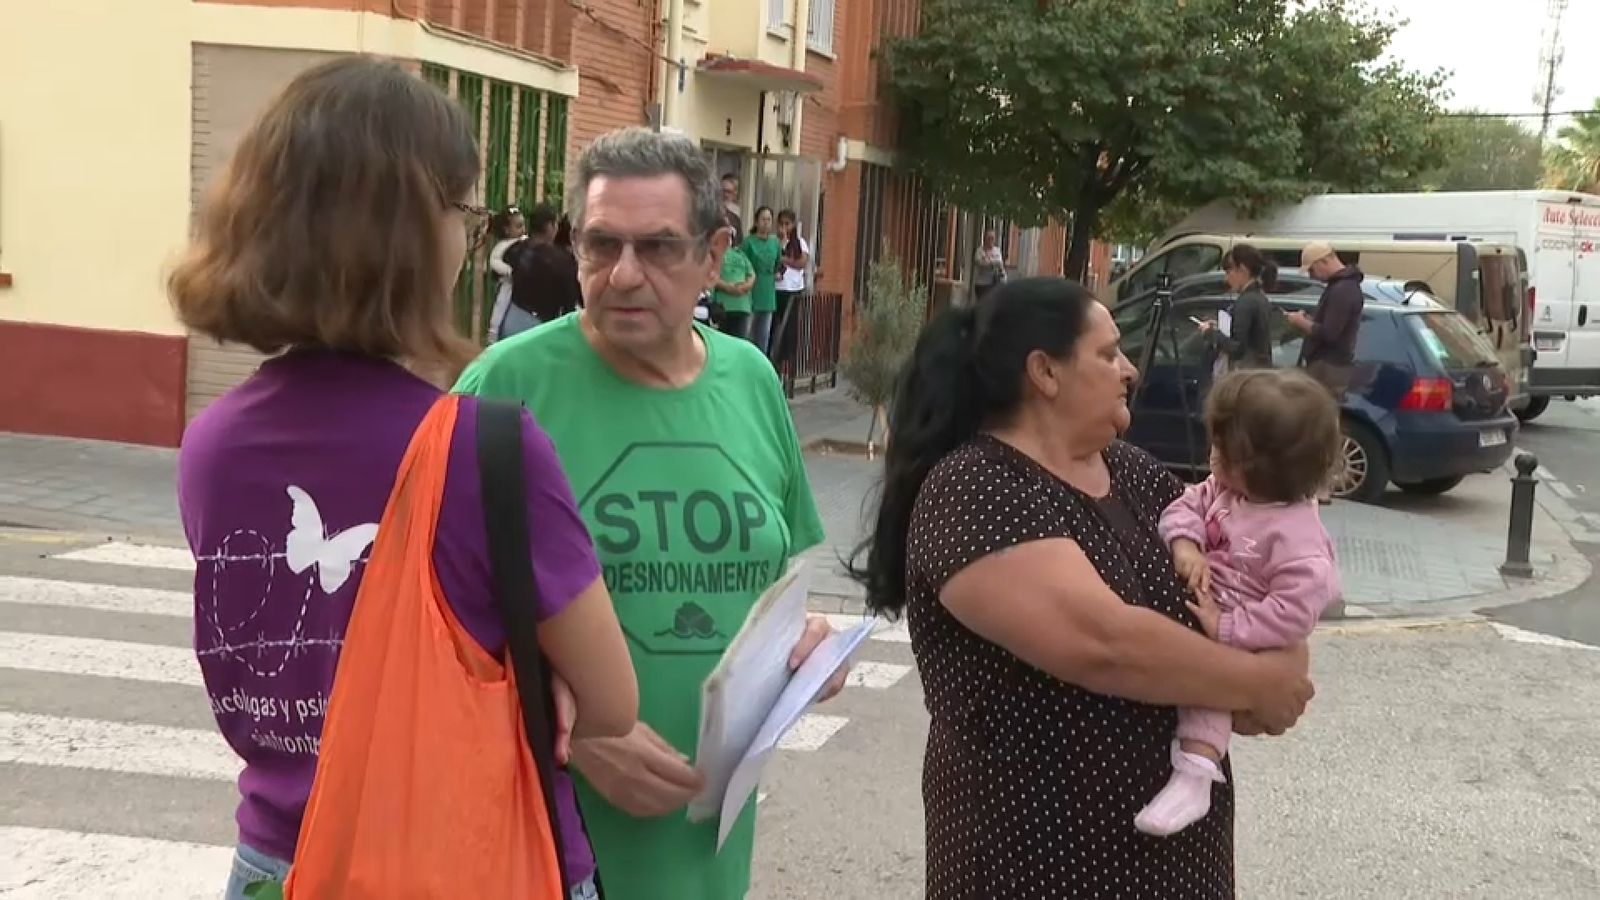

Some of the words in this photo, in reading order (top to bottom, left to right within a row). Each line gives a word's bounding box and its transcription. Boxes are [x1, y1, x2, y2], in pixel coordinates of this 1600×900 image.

[593, 489, 767, 555] STOP
[602, 560, 769, 594] DESNONAMENTS
[279, 699, 290, 724] y
